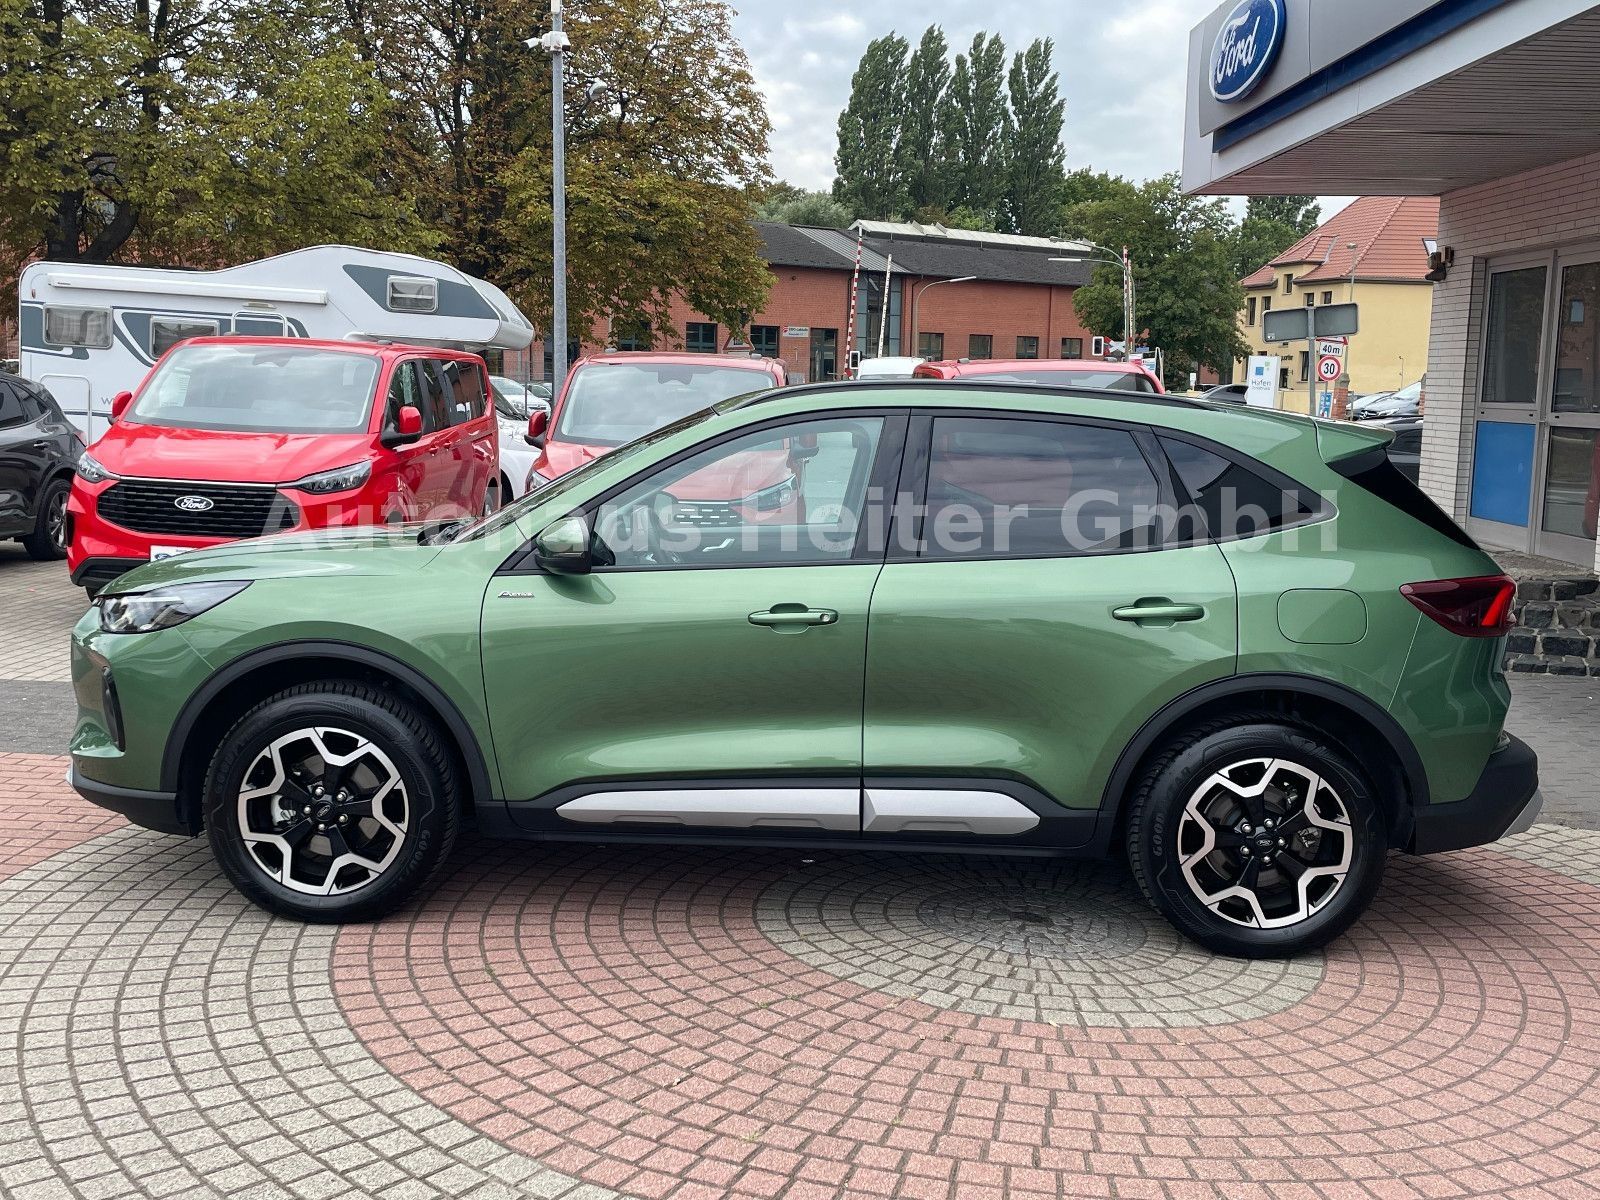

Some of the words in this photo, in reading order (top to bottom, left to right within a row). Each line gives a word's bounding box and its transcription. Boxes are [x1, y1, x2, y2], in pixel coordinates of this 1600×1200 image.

[1214, 9, 1261, 84] Ford
[1323, 363, 1335, 375] 30
[180, 497, 208, 509] Ford
